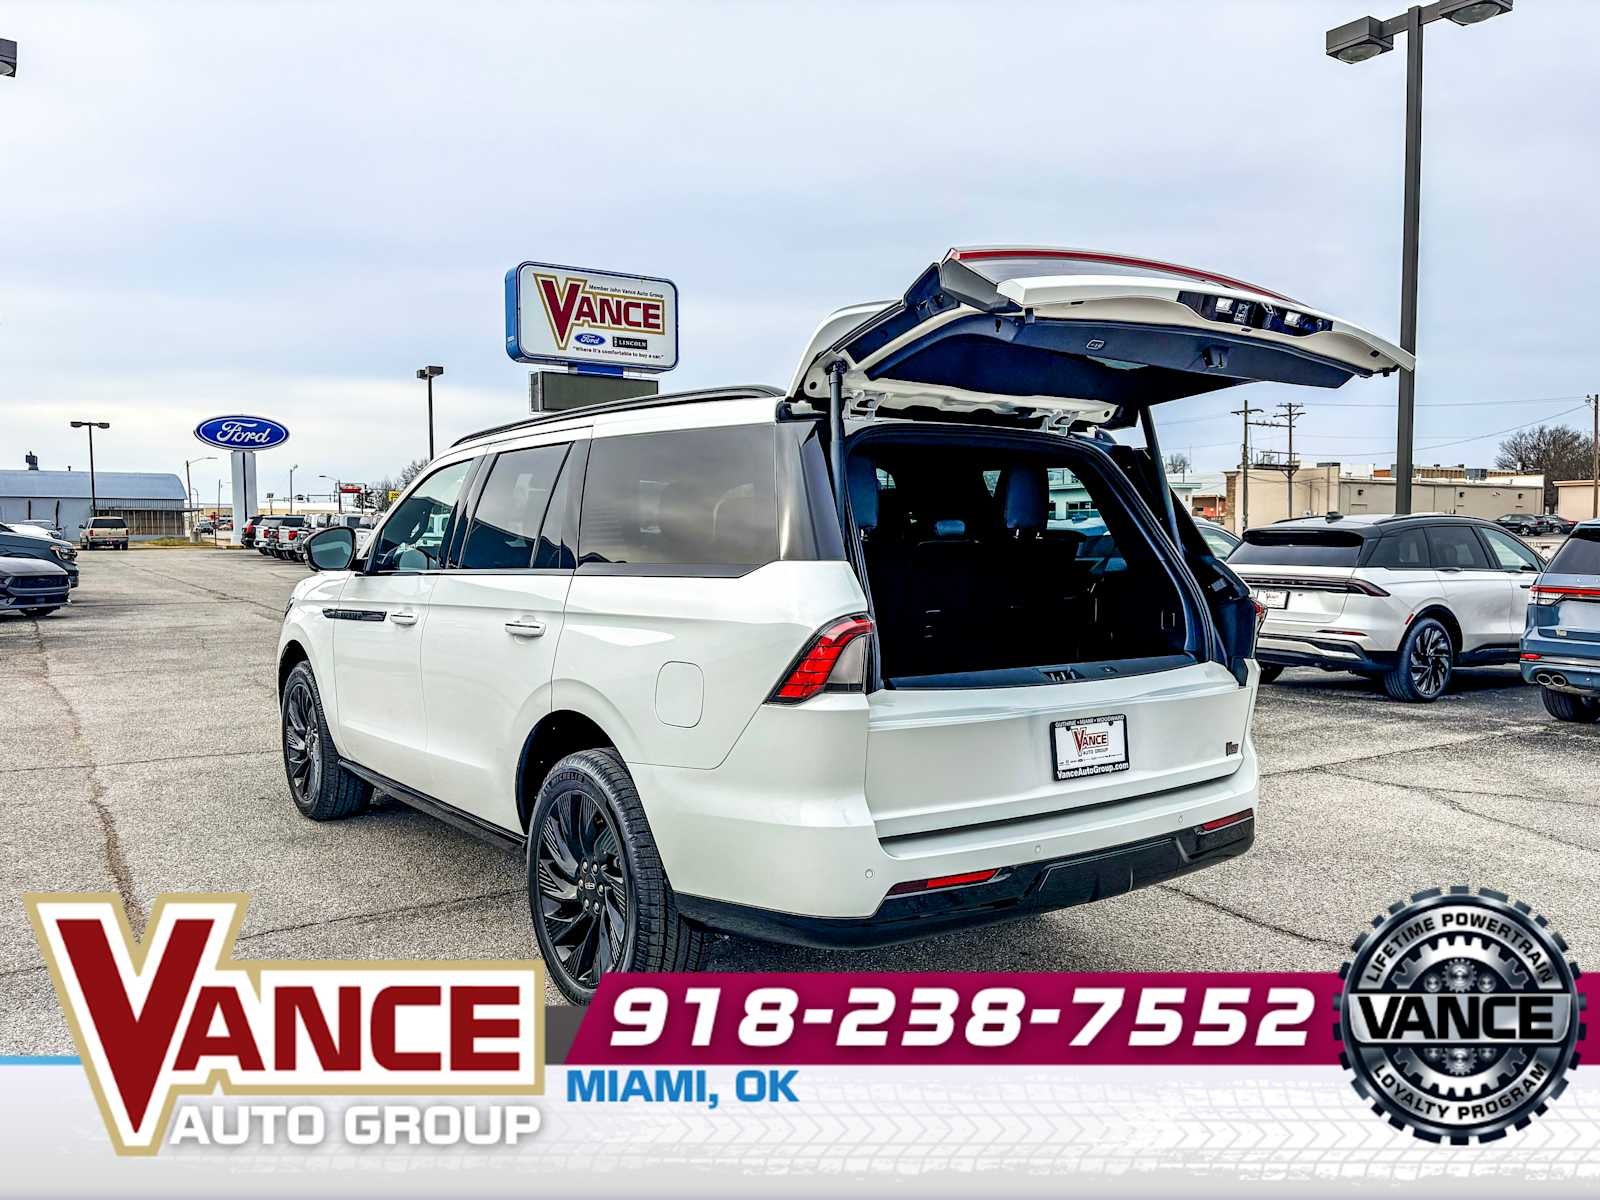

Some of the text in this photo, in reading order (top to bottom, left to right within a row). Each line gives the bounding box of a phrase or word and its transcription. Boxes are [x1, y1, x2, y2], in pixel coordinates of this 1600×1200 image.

[589, 284, 609, 292] Member
[649, 291, 664, 299] Group
[538, 277, 663, 346] VANCE
[581, 334, 600, 344] Ford
[619, 339, 646, 347] LINCOLN
[602, 349, 632, 357] comfortable
[216, 421, 272, 443] Ford
[1072, 729, 1108, 753] VANCE
[1057, 762, 1129, 780] VanceAutoGroup.com
